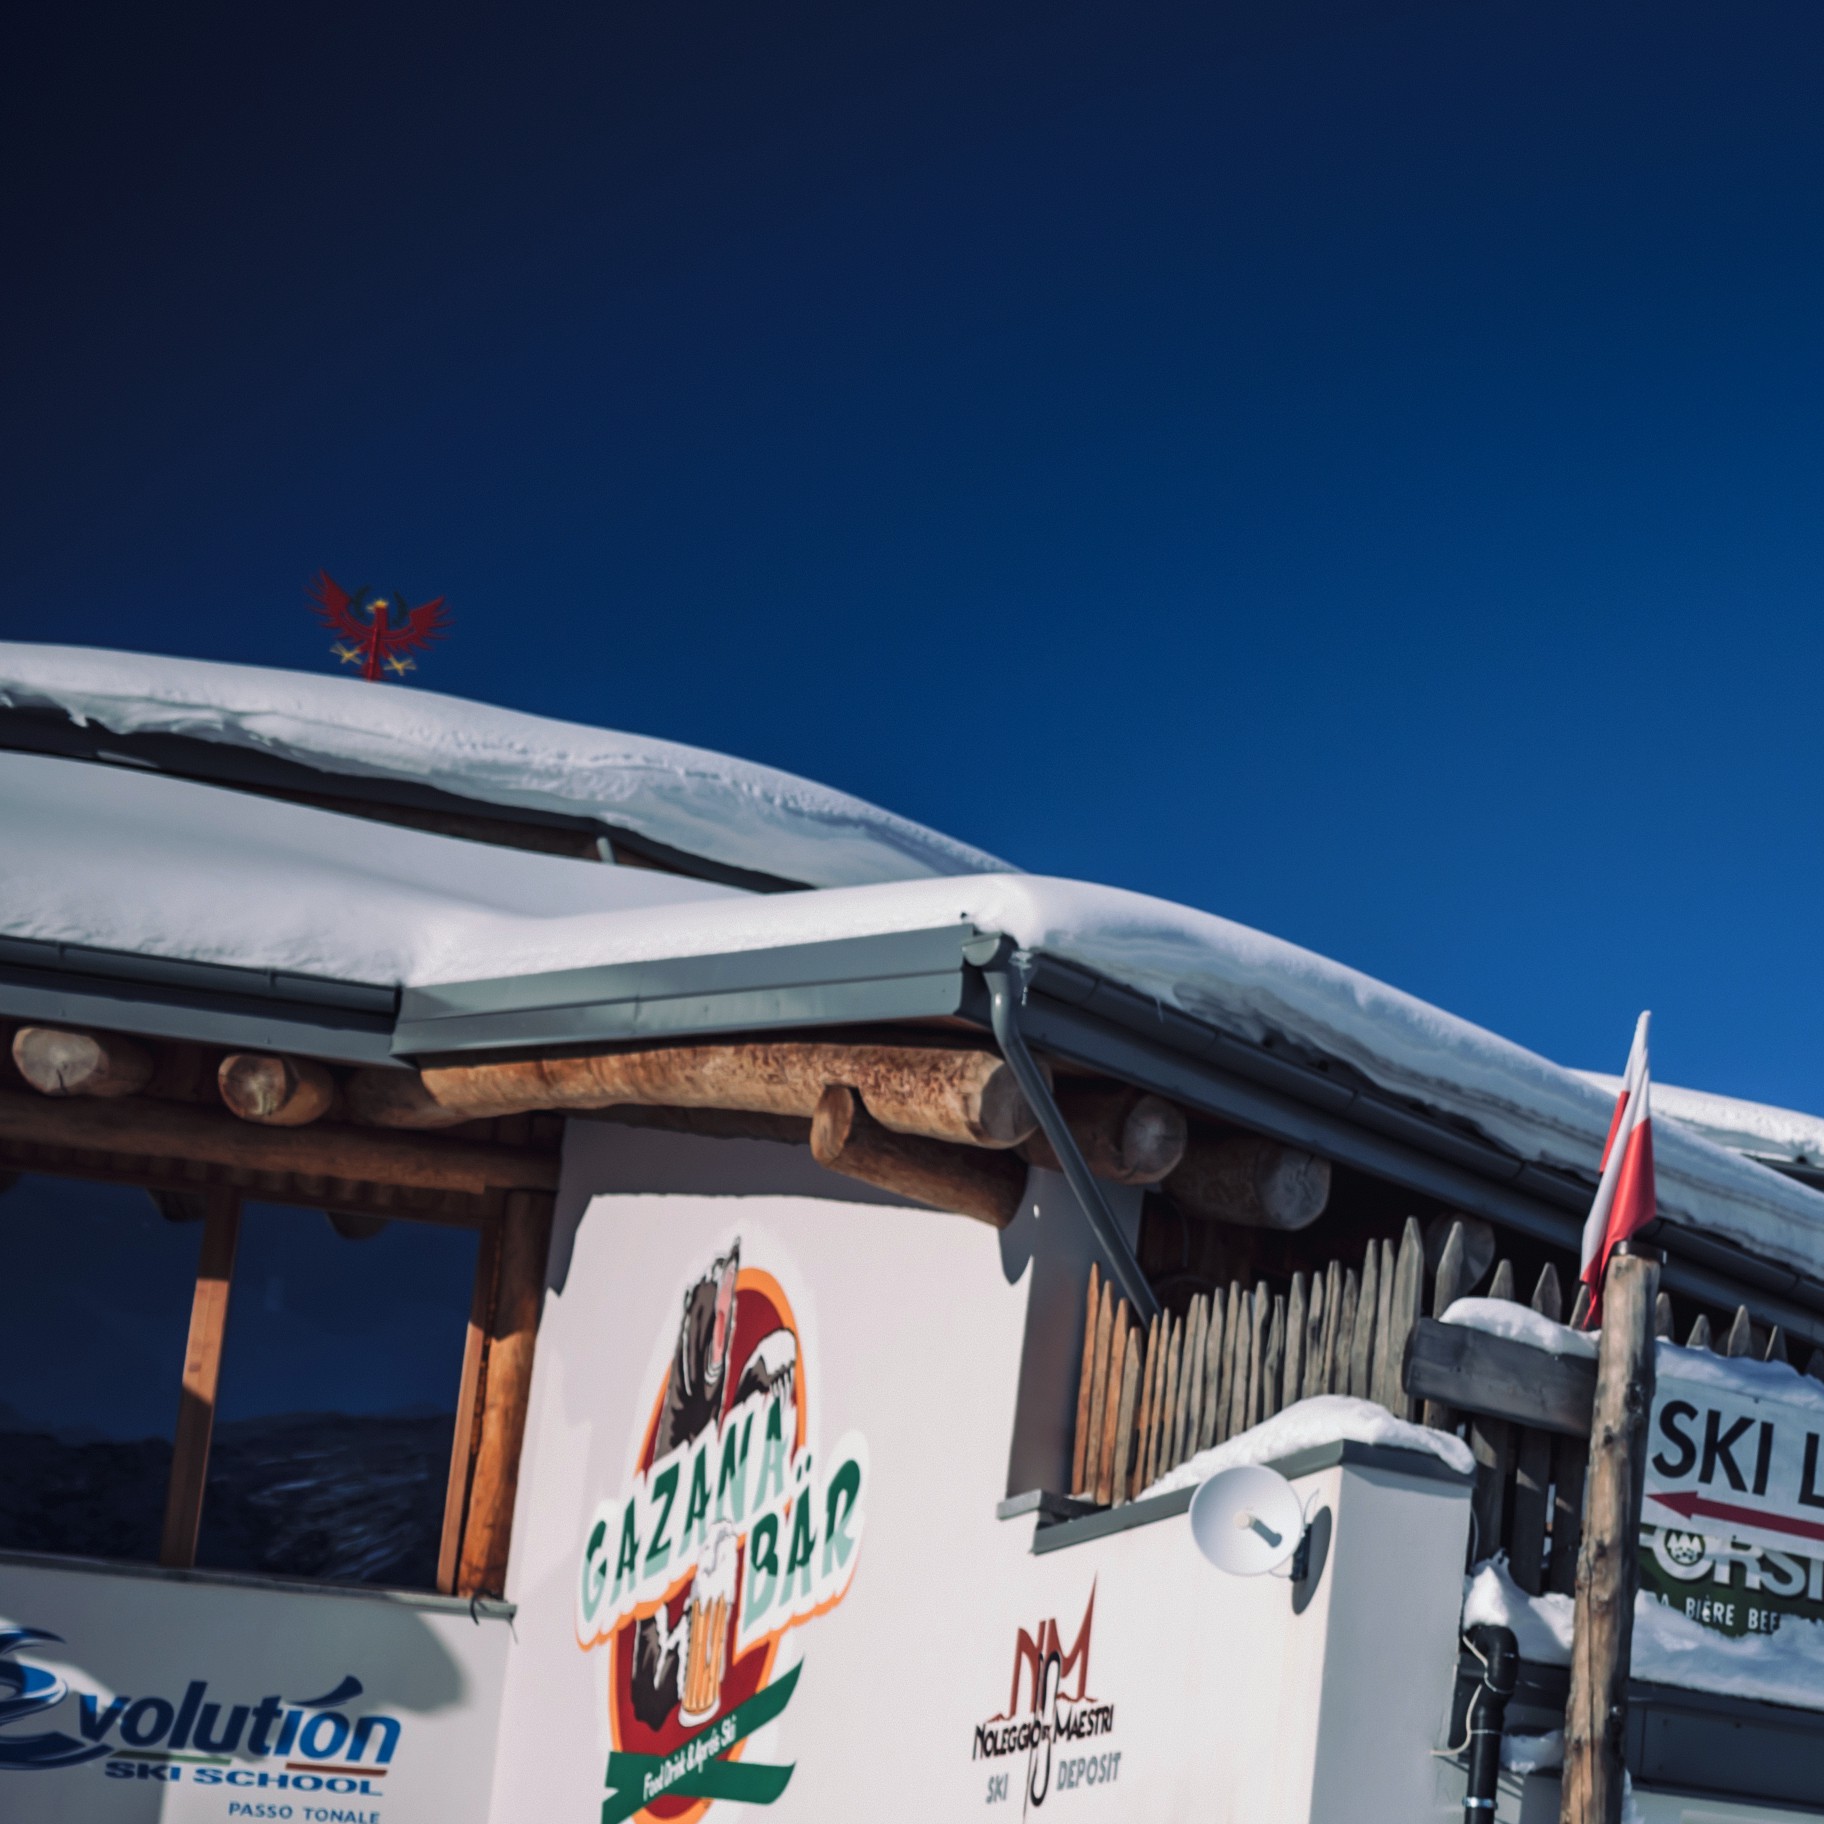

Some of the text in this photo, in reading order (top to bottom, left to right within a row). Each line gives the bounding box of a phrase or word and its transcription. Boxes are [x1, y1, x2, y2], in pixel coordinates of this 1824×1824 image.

[1652, 1400, 1774, 1497] SKI
[743, 1455, 860, 1633] BÄR
[1748, 1608, 1780, 1632] BEE
[104, 1761, 384, 1796] SKI SCHOOL
[985, 1752, 1122, 1804] SKI DEPOSIT
[228, 1802, 293, 1820] PASSO
